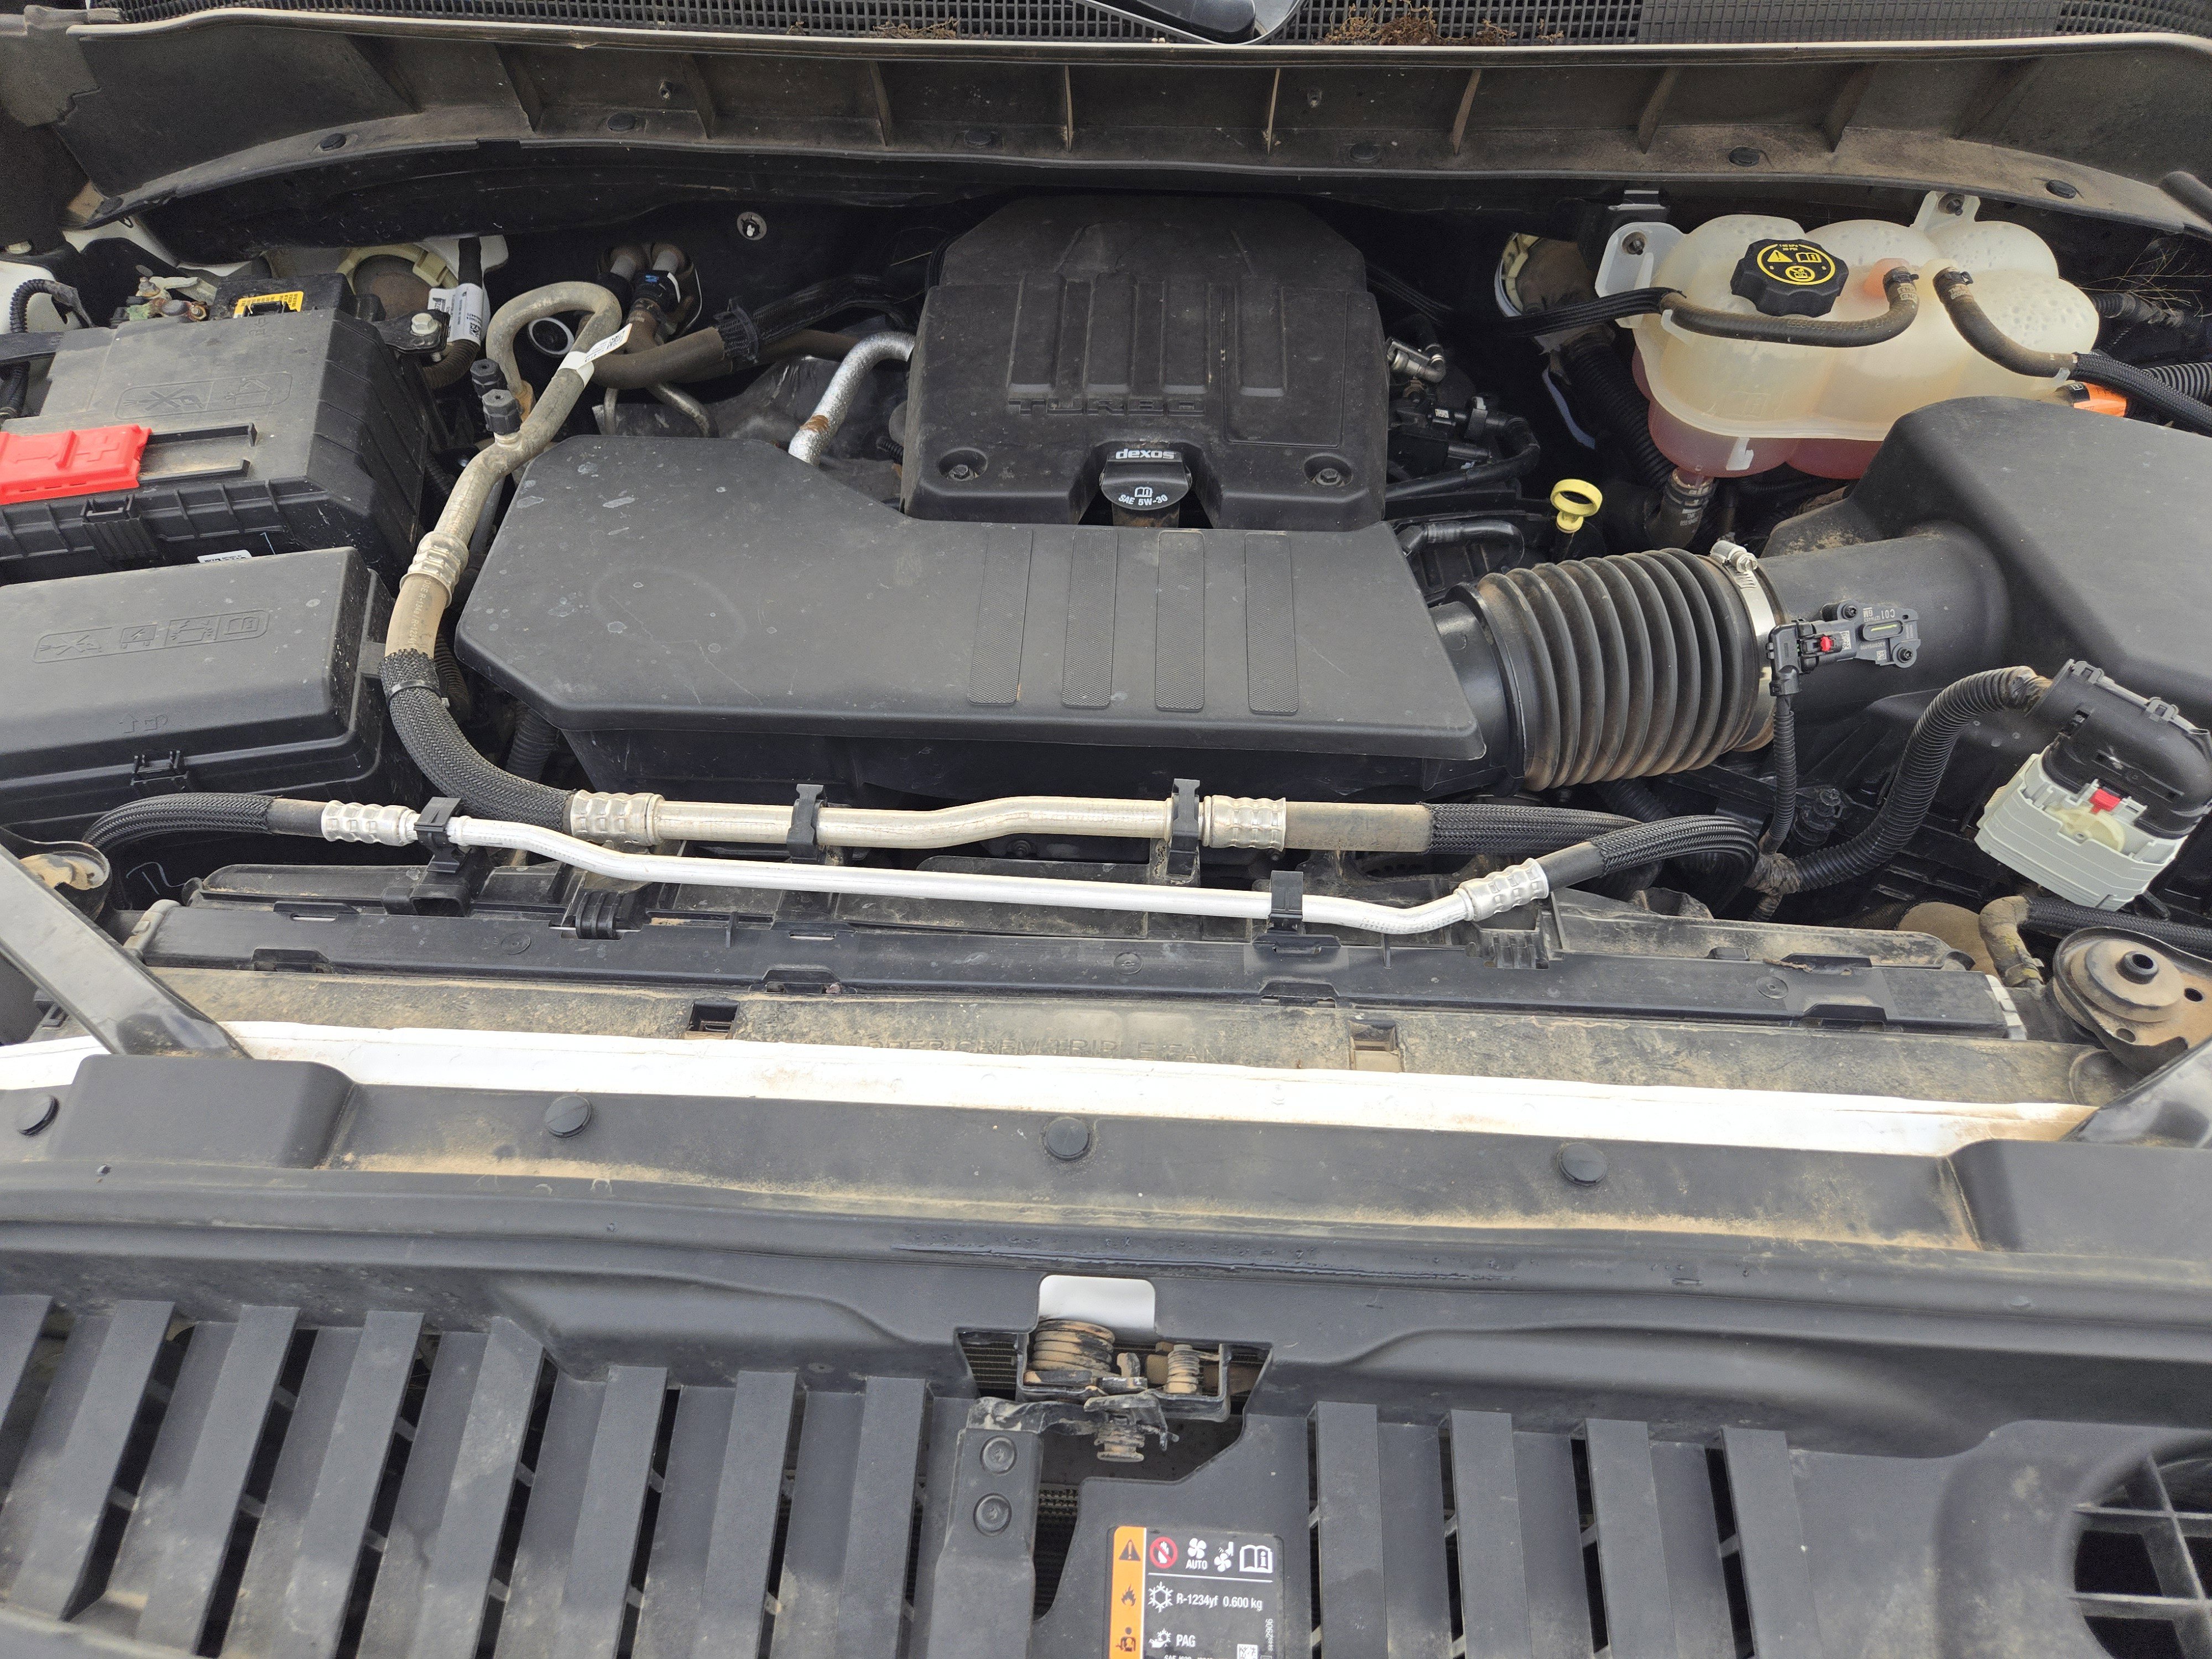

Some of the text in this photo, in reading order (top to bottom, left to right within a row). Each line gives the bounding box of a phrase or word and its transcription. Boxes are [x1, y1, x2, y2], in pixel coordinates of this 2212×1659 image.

[1008, 398, 1205, 416] TURBO
[1115, 448, 1175, 459] dexos
[1118, 494, 1168, 506] SAE 5W-30
[1185, 1559, 1208, 1569] AUTO
[1176, 1592, 1263, 1612] R-1234yf 0.600 kg
[1176, 1634, 1196, 1647] PAG
